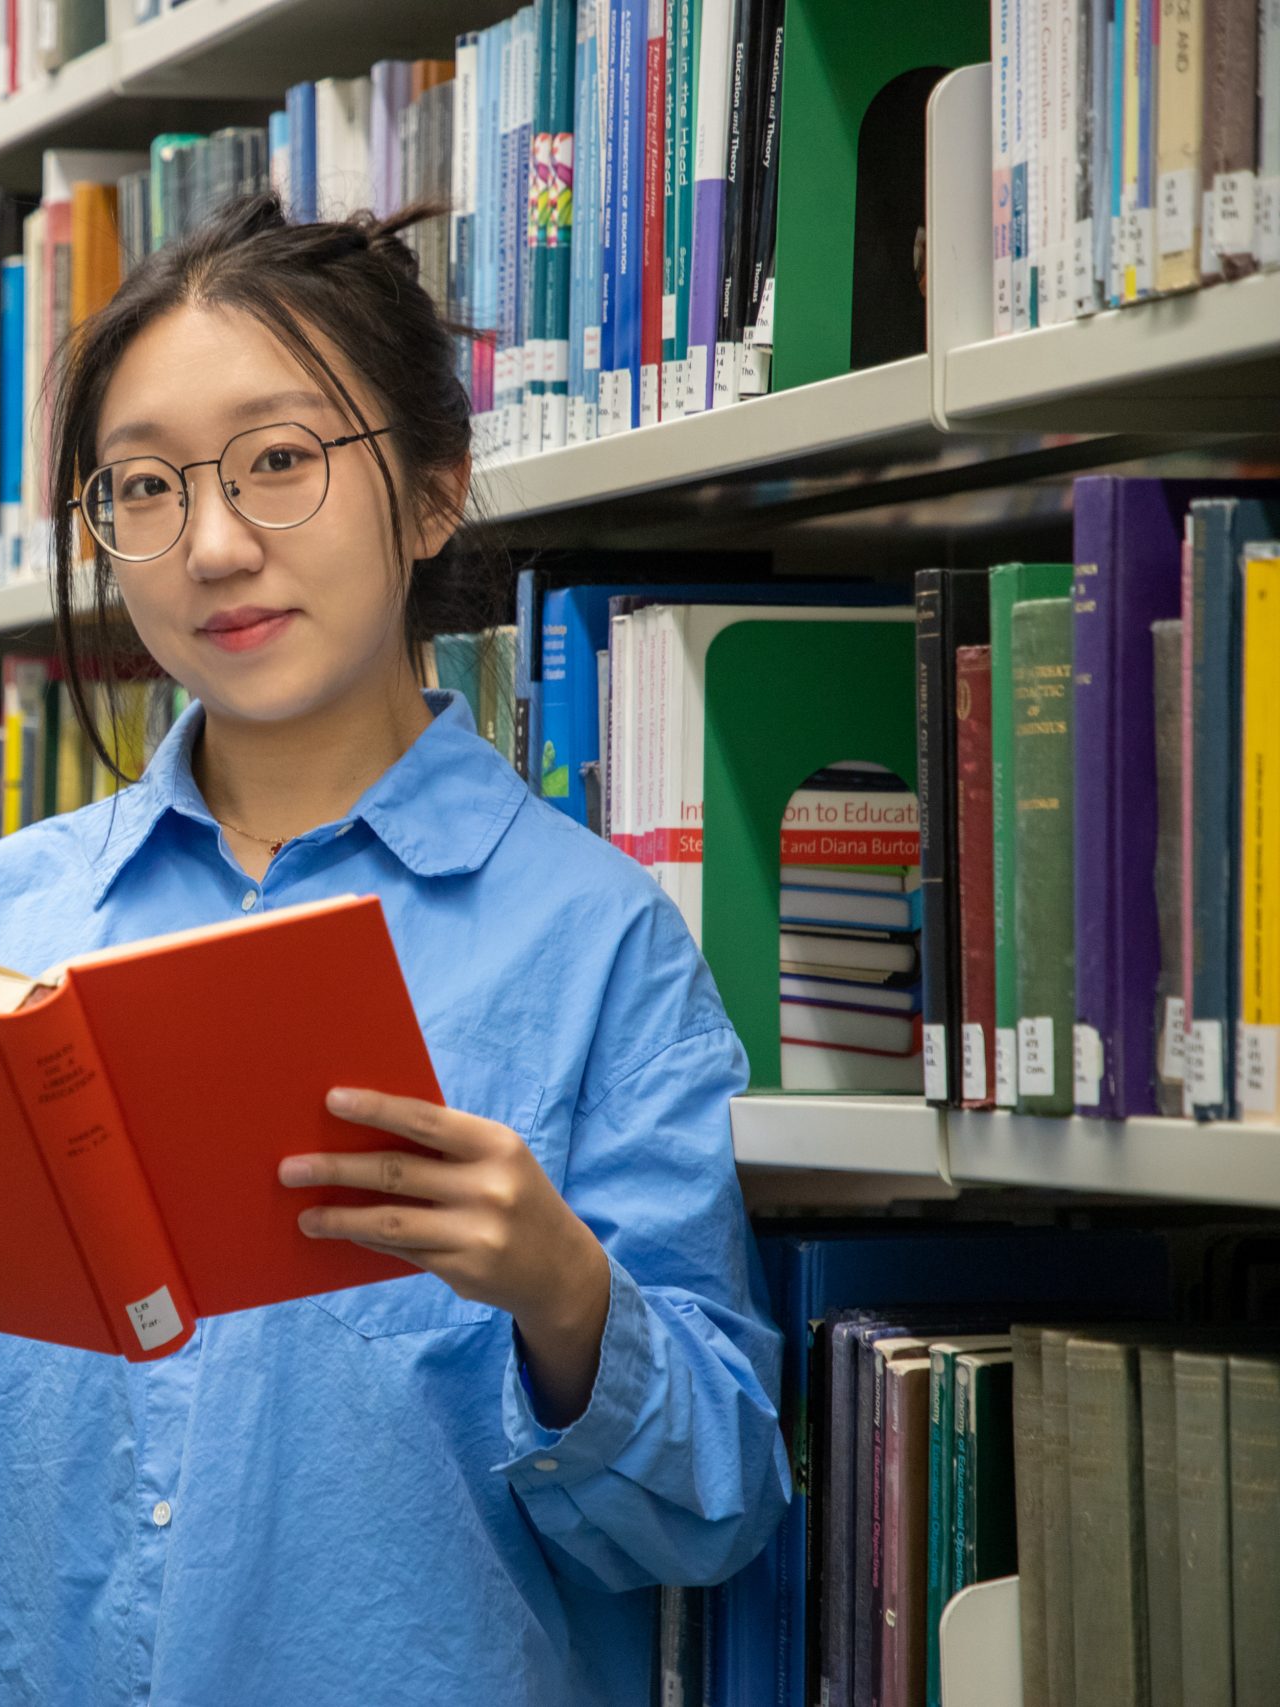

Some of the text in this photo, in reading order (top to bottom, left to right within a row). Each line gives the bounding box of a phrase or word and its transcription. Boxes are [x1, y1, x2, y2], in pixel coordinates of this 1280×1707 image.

[678, 0, 691, 187] eels in the Head
[1040, 26, 1052, 139] Curriculum
[1061, 16, 1072, 131] Curriculum
[663, 0, 676, 197] heels in the Head
[727, 42, 745, 184] Education and Theory
[762, 26, 784, 169] Education and Theory
[1000, 55, 1009, 154] Research
[650, 45, 661, 218] The Therapy of Education
[621, 119, 630, 192] PERSPECTIVE
[621, 194, 628, 210] OF
[620, 211, 628, 275] EDUCATION
[677, 246, 688, 288] Spring
[751, 261, 763, 304] Thomas
[723, 276, 732, 319] Thomas
[716, 346, 726, 356] LB
[744, 330, 754, 340] LB
[744, 343, 751, 351] 14
[676, 363, 683, 372] LB
[676, 375, 682, 384] 14
[716, 358, 724, 367] 14
[741, 367, 756, 376] Tho.
[714, 383, 729, 392] Tho.
[919, 662, 930, 849] AUBREY ON EDUCATION
[815, 802, 838, 823] to
[790, 839, 816, 854] and
[820, 836, 867, 855] Diana
[134, 1301, 150, 1313] LB
[137, 1313, 144, 1323] 7
[871, 1373, 882, 1588] xonomy of Educational Objectives
[930, 1374, 941, 1588] xonomy of Educational Objectives
[955, 1383, 966, 1592] xonomy of Educational Objective
